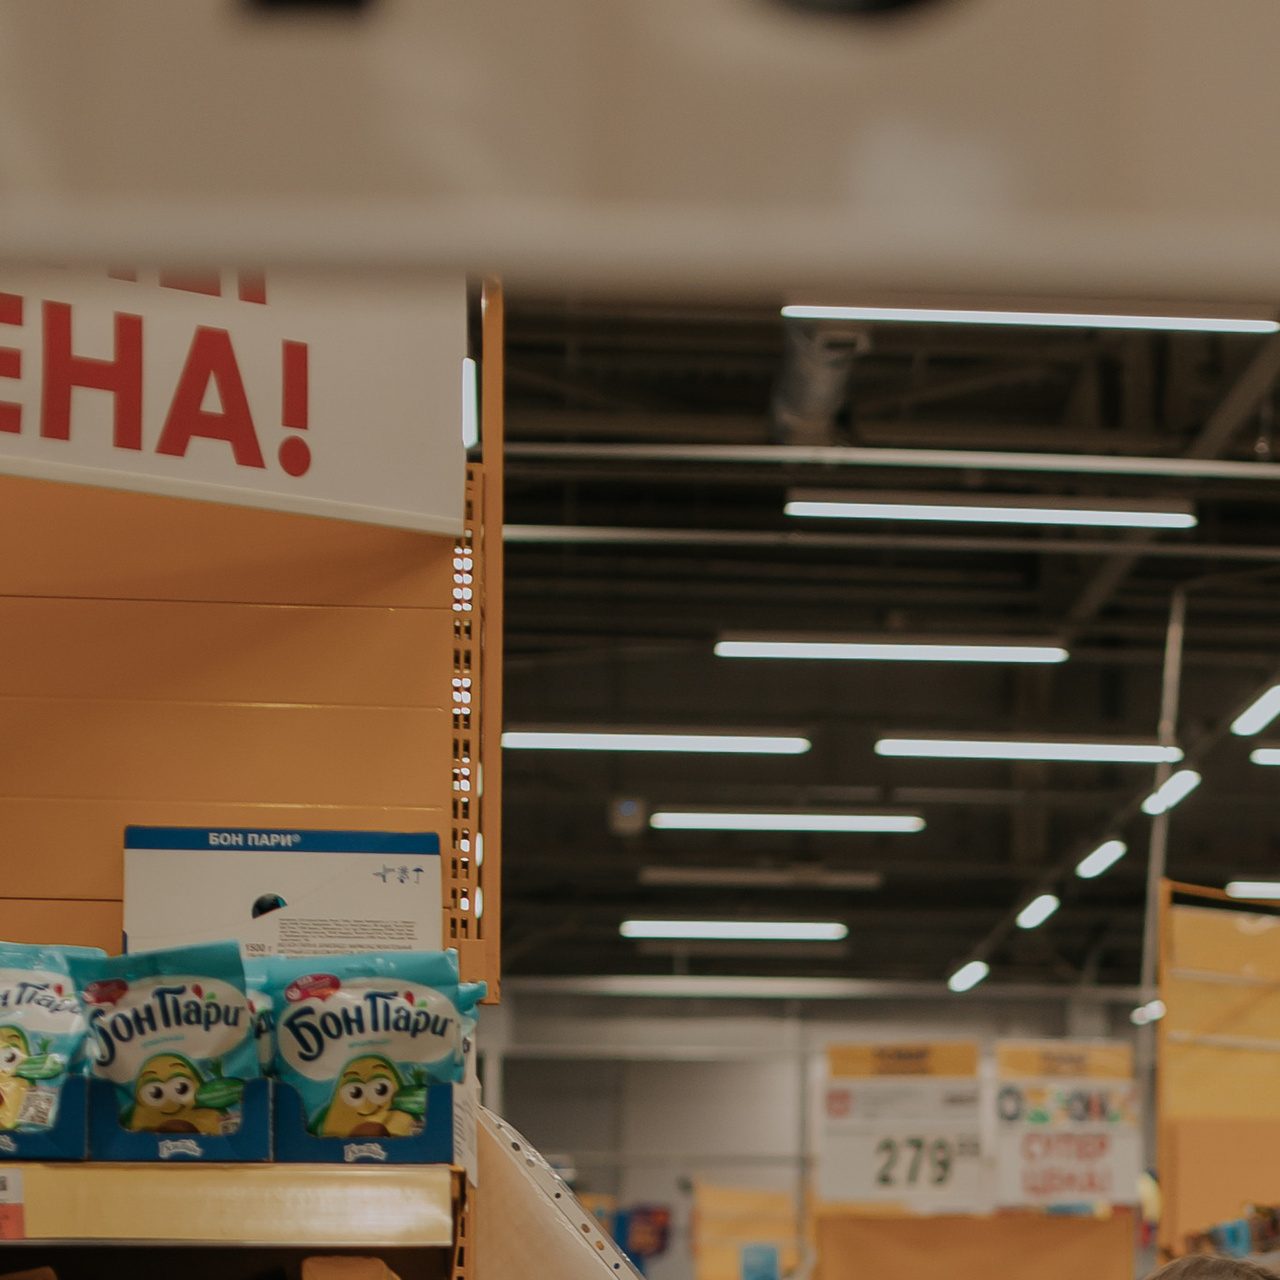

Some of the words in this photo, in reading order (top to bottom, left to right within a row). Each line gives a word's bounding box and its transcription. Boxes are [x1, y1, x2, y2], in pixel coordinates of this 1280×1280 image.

[208, 831, 244, 846] БОН
[152, 985, 245, 1032] Пари
[283, 1005, 365, 1062] Бон
[364, 990, 453, 1038] Пари
[875, 1137, 952, 1186] 279
